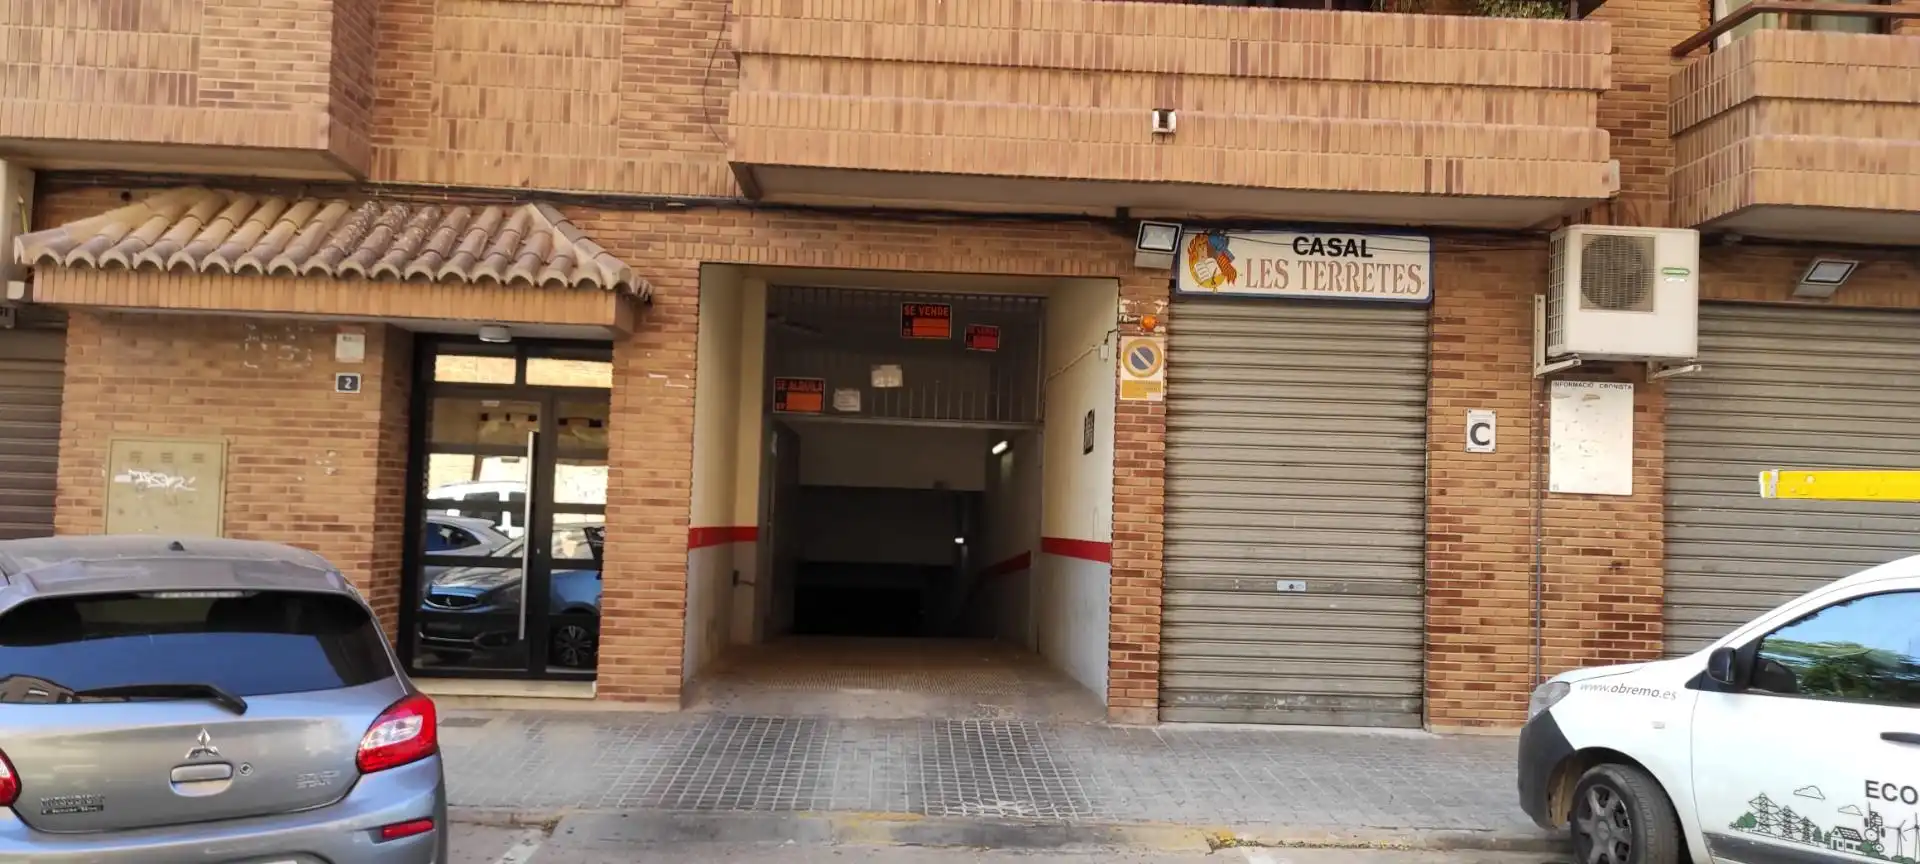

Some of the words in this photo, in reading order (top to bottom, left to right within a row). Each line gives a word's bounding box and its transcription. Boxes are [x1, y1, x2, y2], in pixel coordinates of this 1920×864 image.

[1293, 236, 1373, 258] CASAL
[1245, 257, 1289, 290] LES
[1297, 259, 1423, 295] TERRETES
[903, 305, 916, 316] SE
[918, 305, 949, 317] VENDE
[344, 377, 352, 390] 2
[1470, 422, 1490, 446] C
[1580, 683, 1677, 701] www.obremo.es
[1865, 779, 1919, 805] ECO
